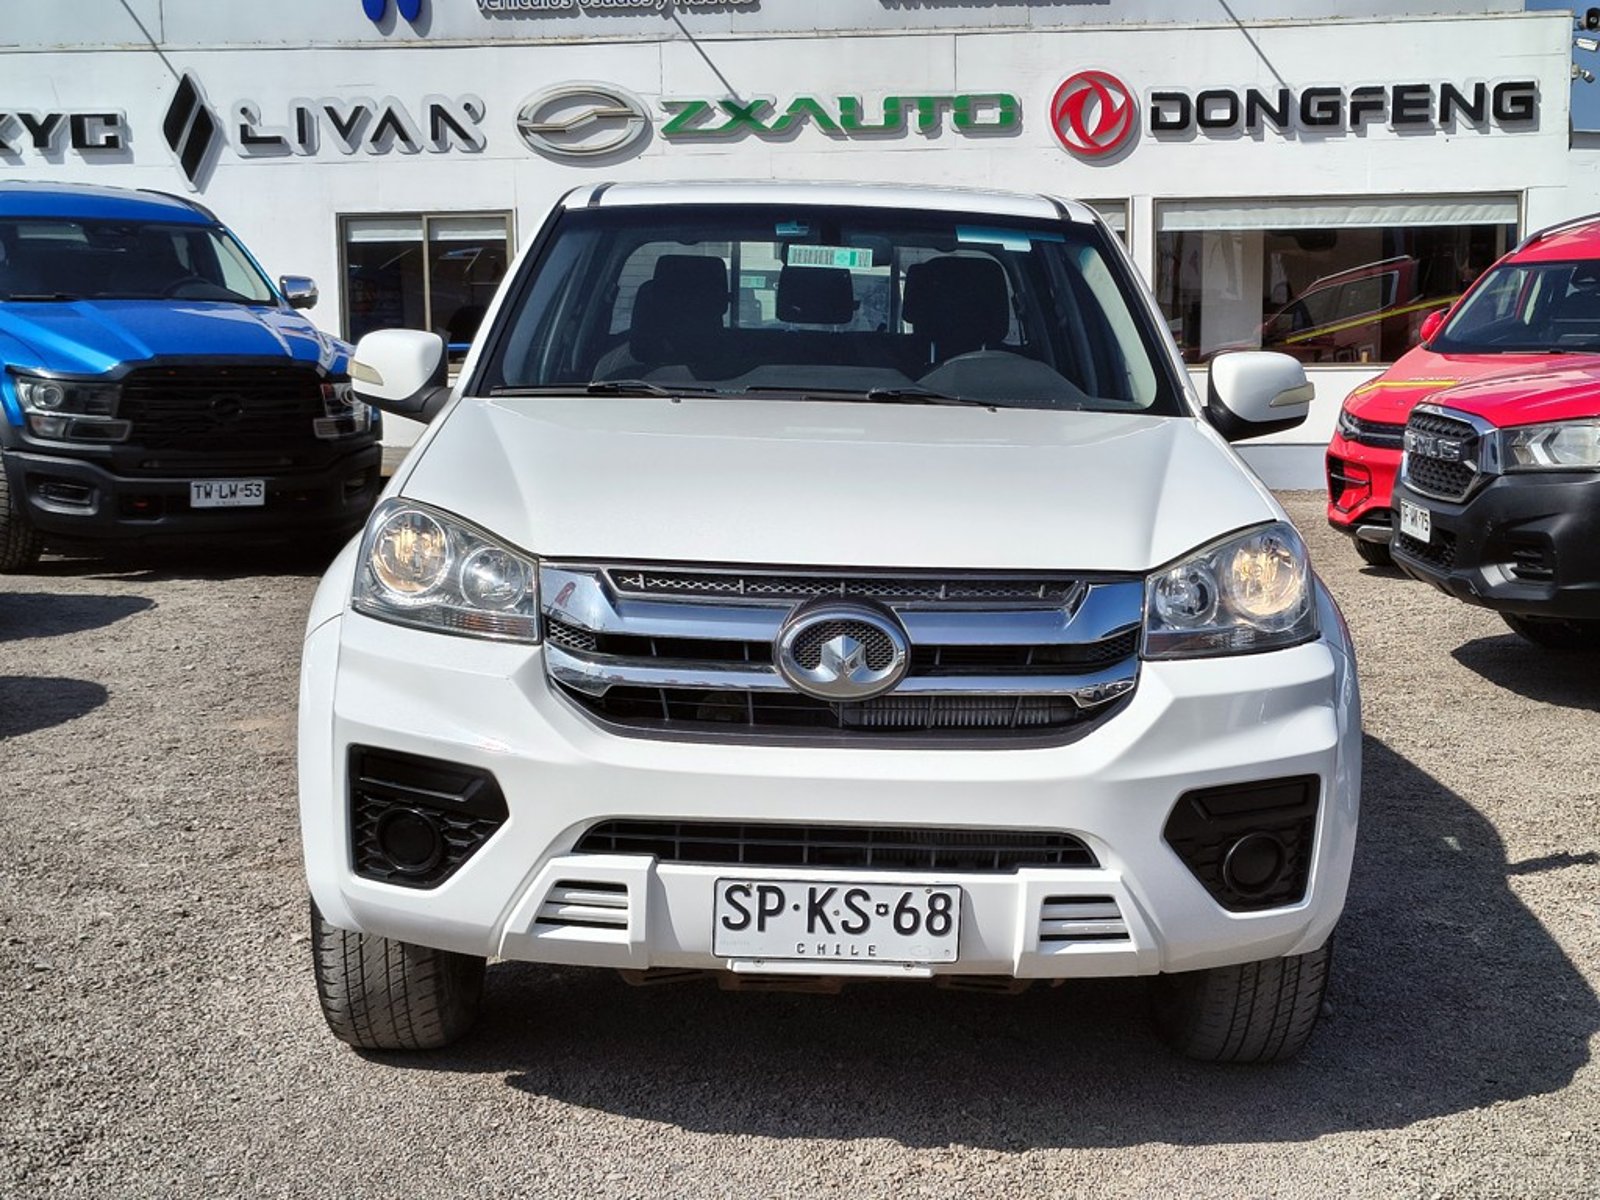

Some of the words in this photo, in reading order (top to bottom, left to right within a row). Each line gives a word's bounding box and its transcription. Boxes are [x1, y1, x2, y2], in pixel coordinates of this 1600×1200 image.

[239, 102, 475, 145] LIVAN
[660, 94, 1017, 134] ZXAUTO
[1151, 81, 1536, 131] DONGFENG
[721, 883, 953, 937] SP·KS·68
[796, 943, 877, 957] CHILE
